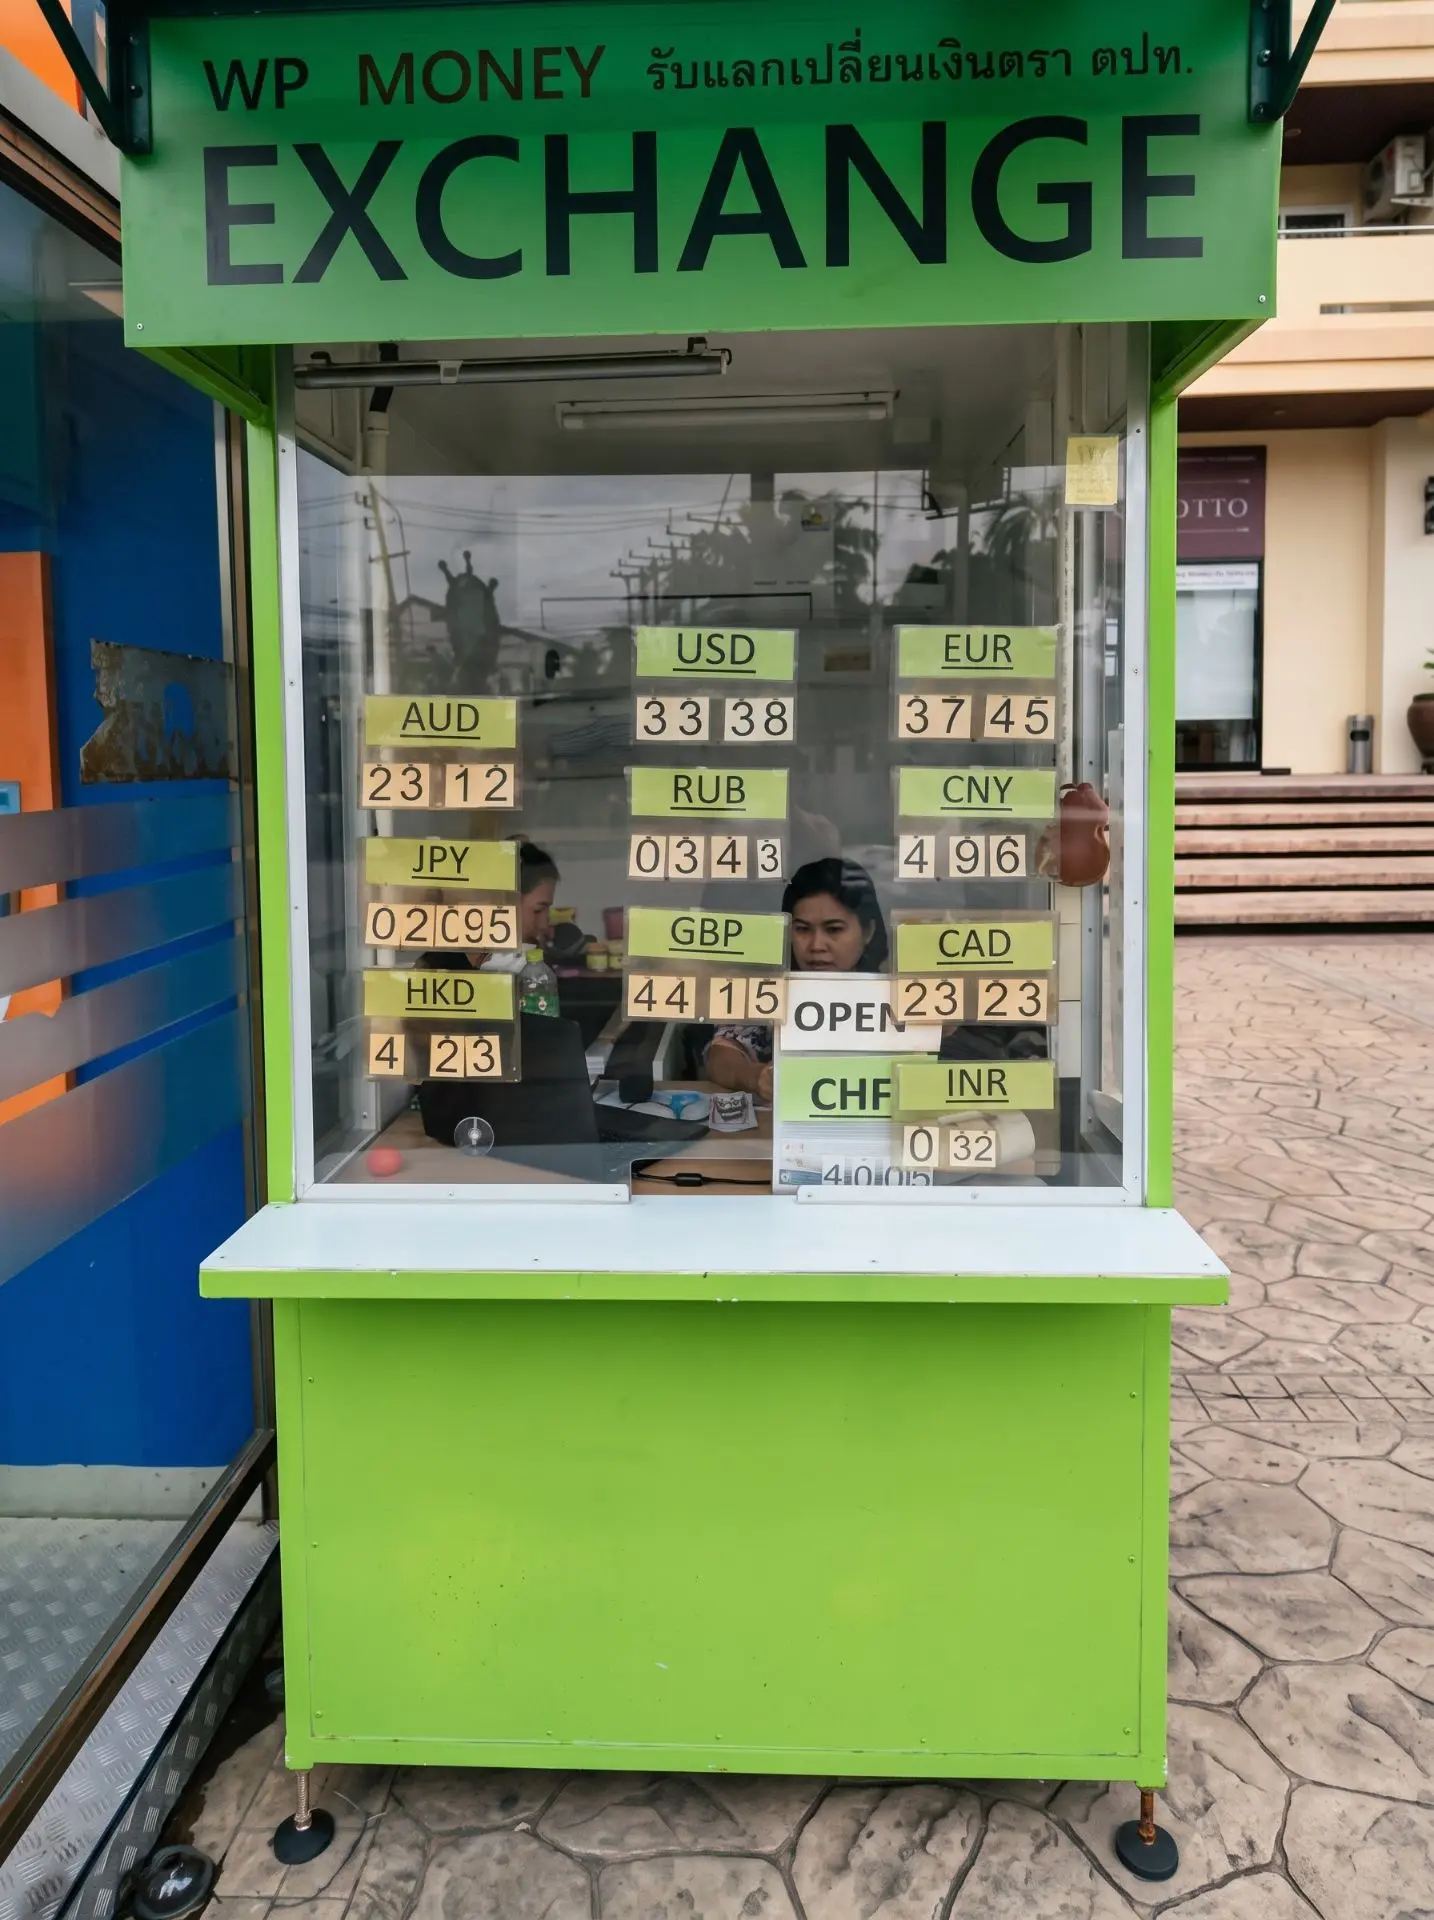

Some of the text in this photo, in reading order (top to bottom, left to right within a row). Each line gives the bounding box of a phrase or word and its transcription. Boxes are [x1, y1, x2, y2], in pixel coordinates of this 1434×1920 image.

[646, 28, 1194, 90] รับแลกเปลี่ยนเงินตรา ตปท.
[203, 45, 607, 112] WP MONEY
[203, 113, 1204, 286] EXCHANGE
[677, 632, 756, 665] USD
[944, 633, 1012, 664] EUR
[401, 702, 480, 733] AUD
[673, 774, 746, 804] RUB
[942, 775, 1014, 804] CNY
[412, 845, 470, 875] JPY
[670, 916, 743, 948] GBP
[938, 929, 1011, 958] CAD
[407, 978, 475, 1006] HKD
[811, 1078, 891, 1111] CHF
[947, 1068, 1008, 1097] INR
